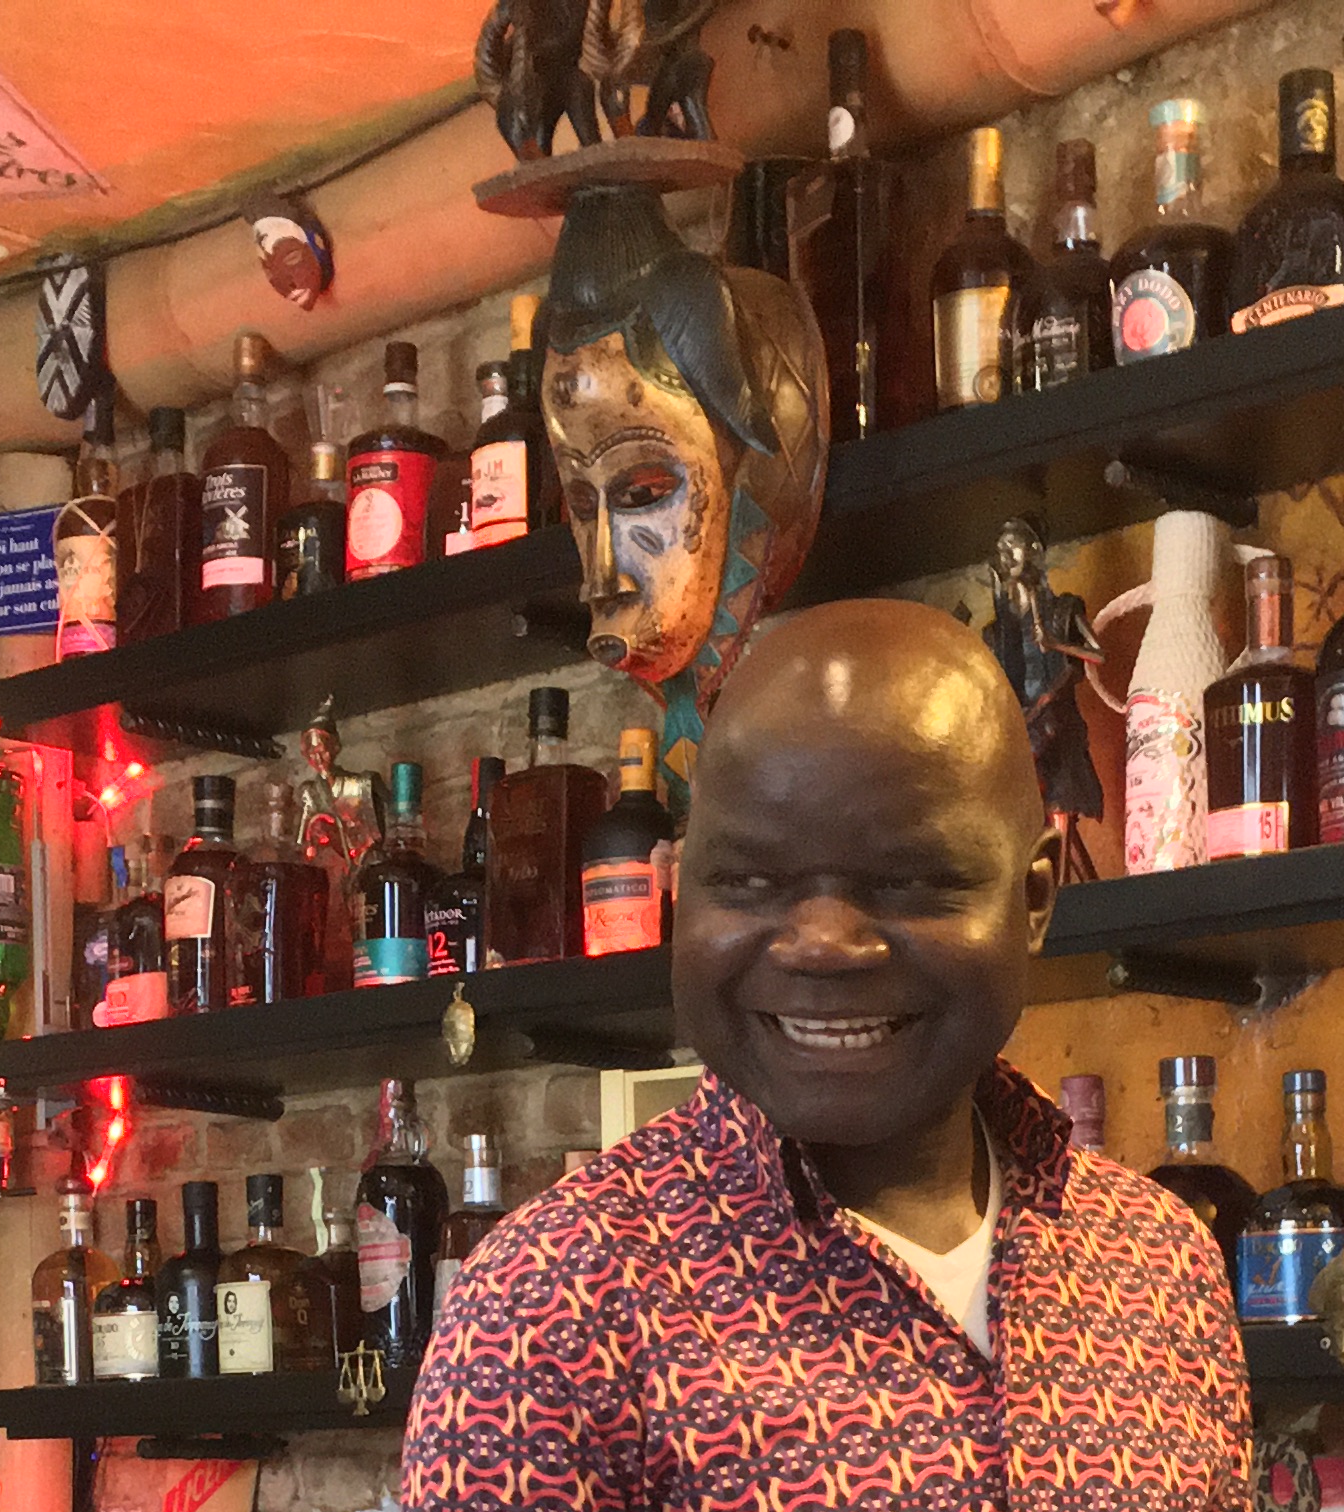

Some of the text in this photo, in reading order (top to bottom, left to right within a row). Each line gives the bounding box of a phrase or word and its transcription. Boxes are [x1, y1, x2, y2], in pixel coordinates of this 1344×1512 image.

[10, 537, 40, 554] haut
[16, 563, 31, 574] se
[12, 600, 38, 613] son
